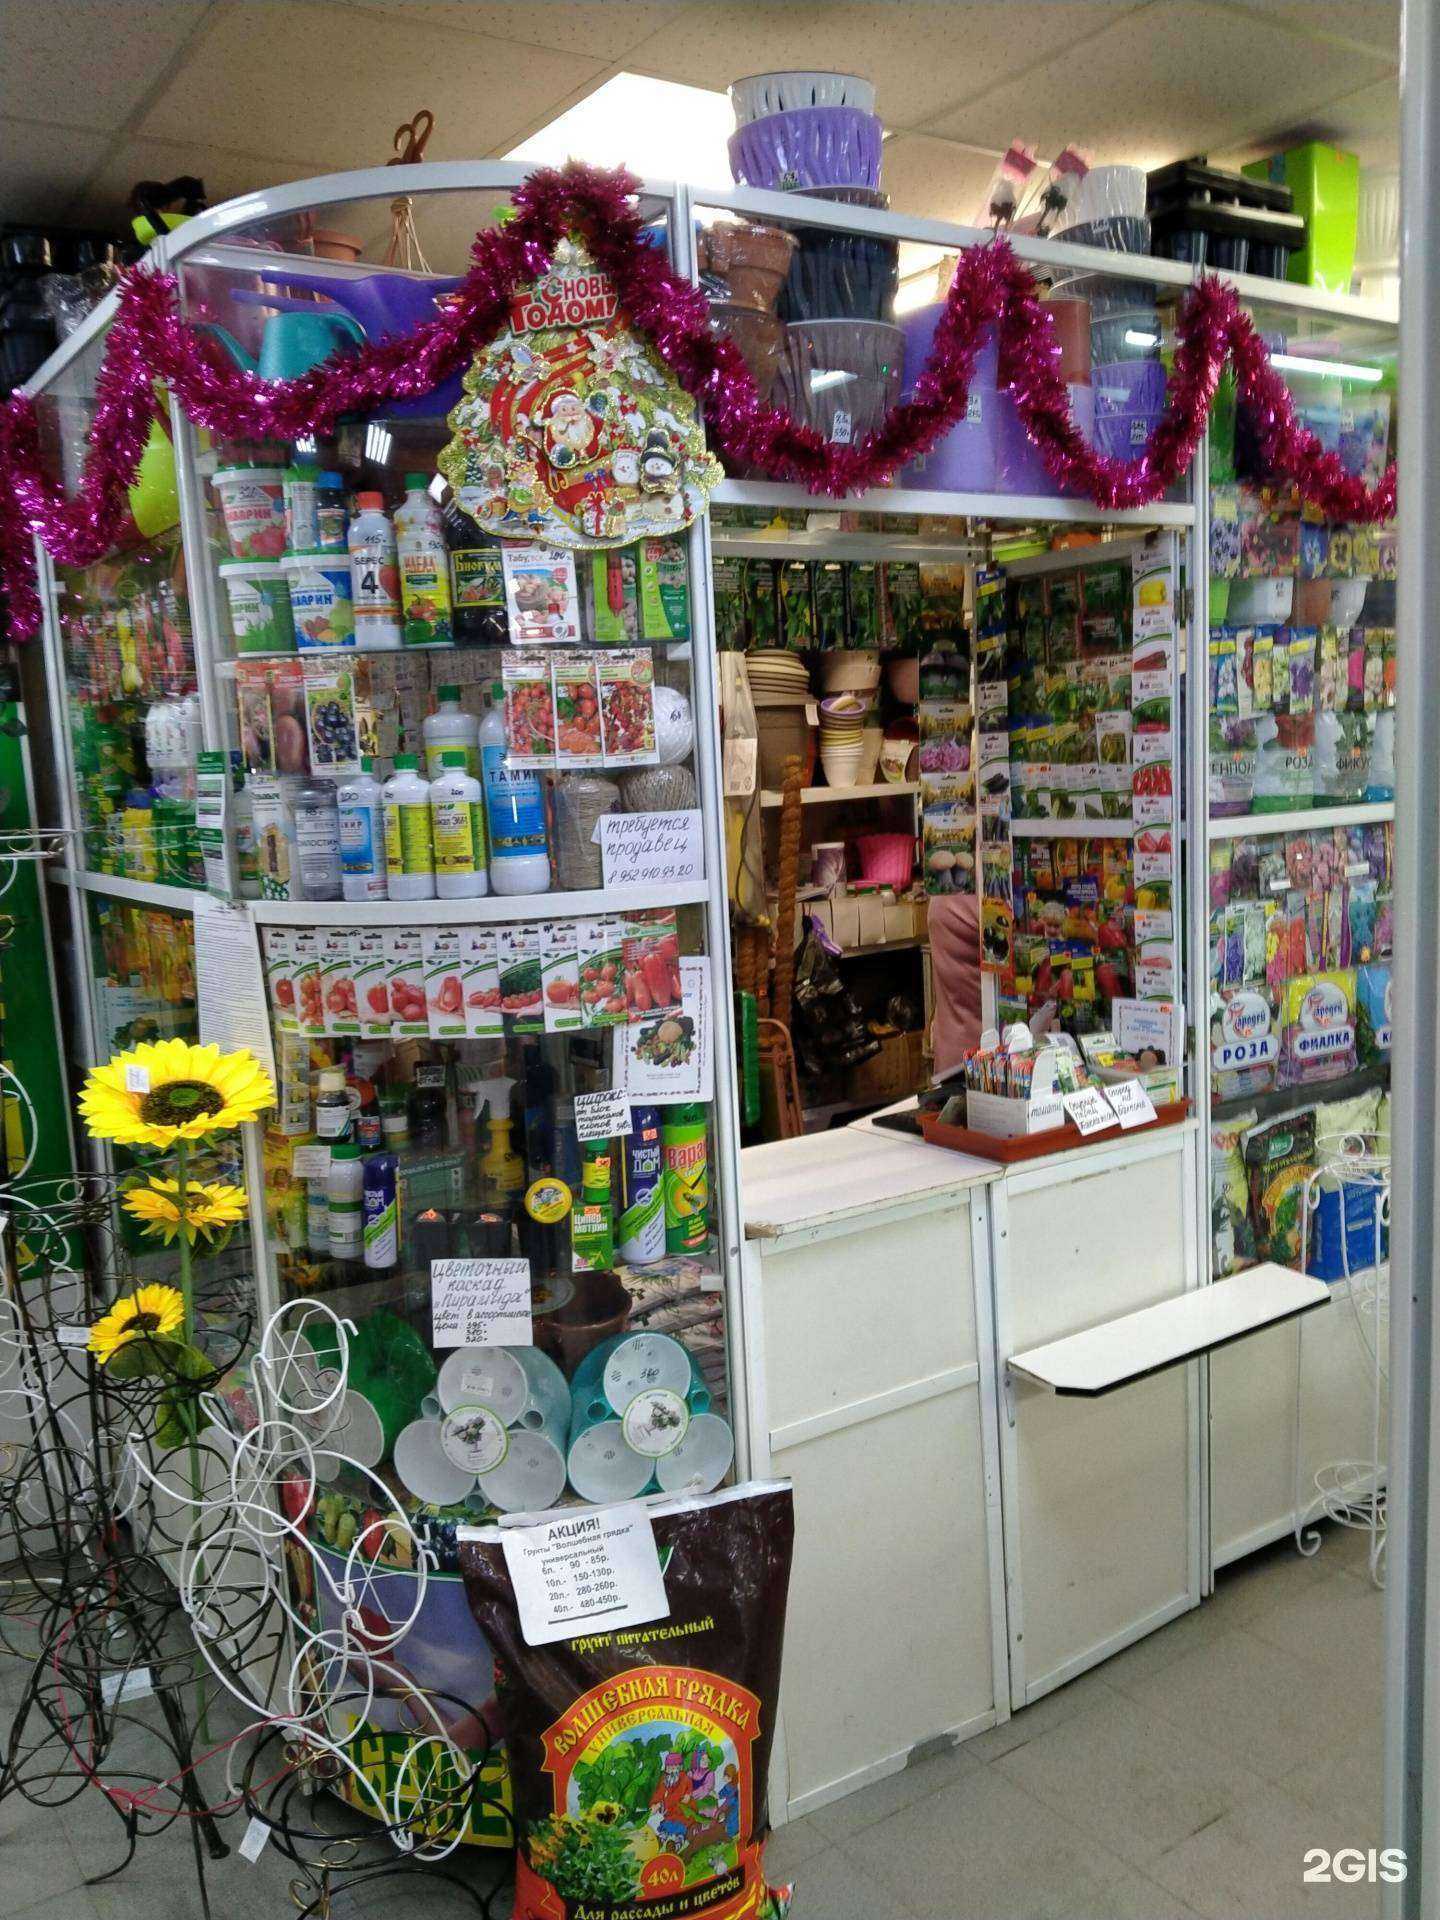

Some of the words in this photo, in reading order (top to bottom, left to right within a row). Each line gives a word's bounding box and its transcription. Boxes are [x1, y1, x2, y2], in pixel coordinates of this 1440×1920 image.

[361, 571, 379, 595] 4
[606, 816, 690, 840] требуется
[606, 833, 689, 864] продавец
[677, 864, 694, 876] 20
[1222, 1040, 1269, 1065] РОЗА
[1299, 1031, 1351, 1052] ФИАЛКА
[667, 1140, 706, 1169] Вара
[548, 1518, 600, 1541] АКЦИЯ!
[523, 1546, 551, 1557] Грунты
[569, 1560, 581, 1570] 90
[554, 1675, 669, 1757] ВОЛШЕБНАЯ
[674, 1676, 751, 1732] ГРЯДКА
